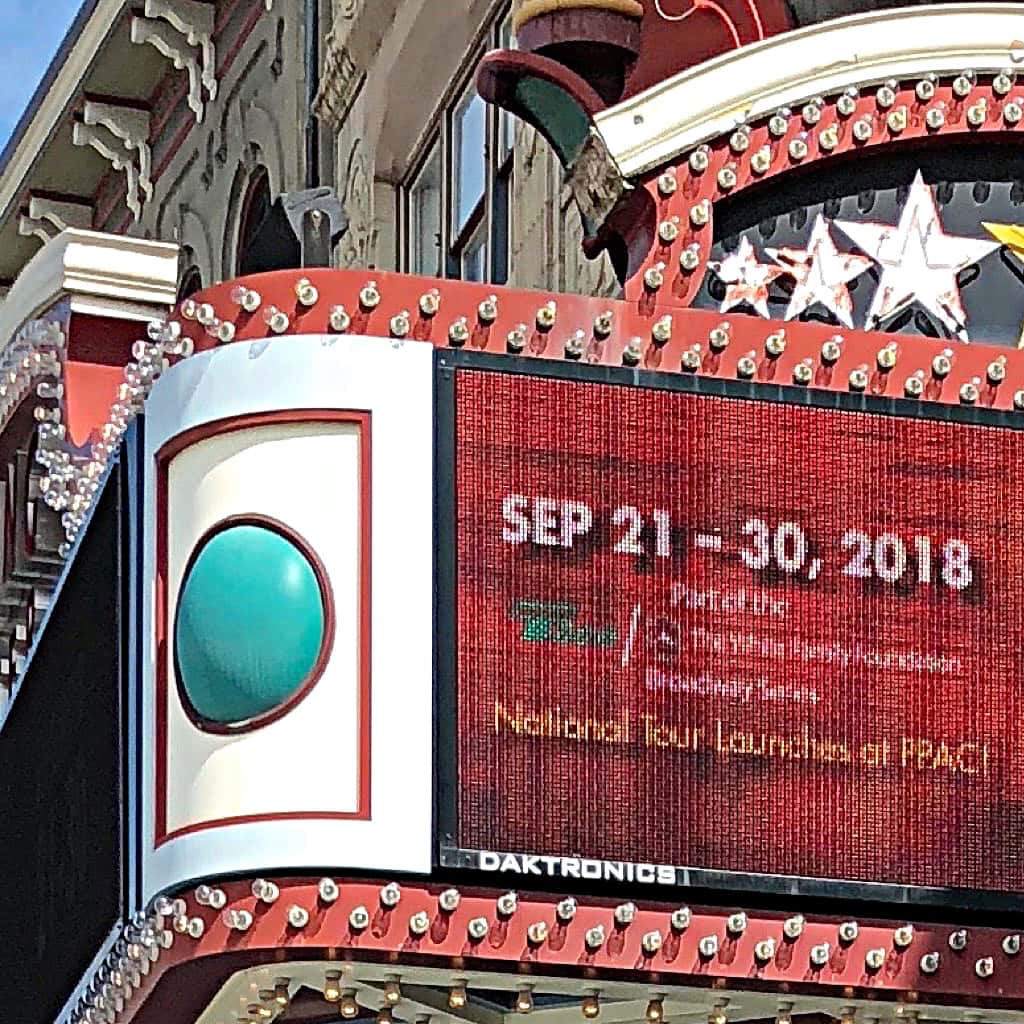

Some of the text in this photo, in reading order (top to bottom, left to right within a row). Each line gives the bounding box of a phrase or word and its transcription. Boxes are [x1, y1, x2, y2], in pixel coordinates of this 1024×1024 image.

[501, 494, 593, 550] SEP
[609, 509, 672, 558] 21
[741, 518, 820, 582] 30,
[840, 533, 974, 591] 2018
[494, 701, 630, 743] National
[641, 711, 706, 750] Tour
[715, 718, 852, 763] Launches
[859, 739, 890, 769] at
[479, 851, 677, 885] DAKTRONICS
